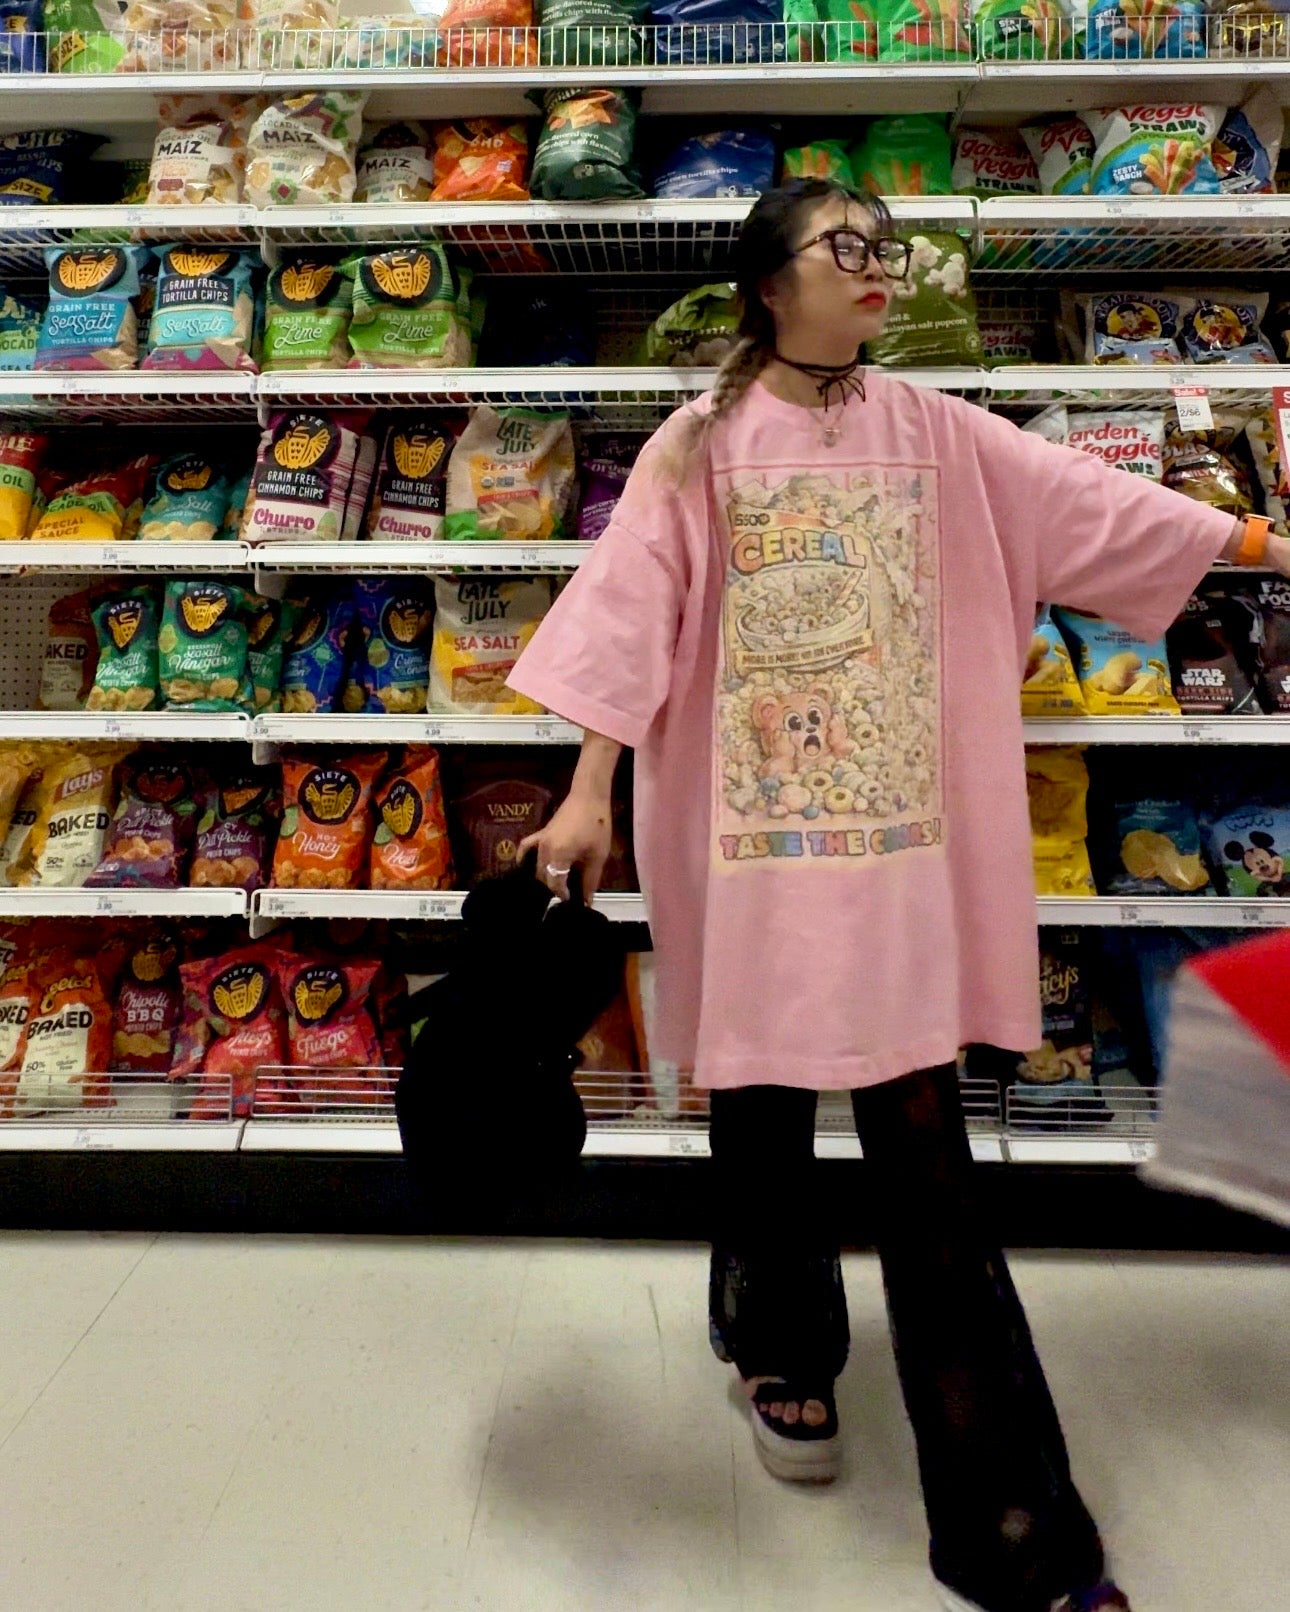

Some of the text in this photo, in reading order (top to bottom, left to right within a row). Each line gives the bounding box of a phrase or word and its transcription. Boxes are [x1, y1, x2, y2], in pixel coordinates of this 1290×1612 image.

[168, 277, 219, 291] GRAIN FREE
[162, 288, 229, 304] TORTILLA CHIPS
[85, 302, 116, 312] FREE
[384, 320, 434, 343] Lime
[918, 317, 968, 330] salt popcorn
[274, 324, 323, 349] Lime
[3, 473, 24, 488] OIL
[267, 470, 317, 486] GRAIN FREE
[257, 482, 325, 500] CINNAMON CHIPS
[391, 479, 433, 496] GRAIN FREE
[383, 490, 440, 509] CINNAMON CHIPS
[36, 516, 84, 531] SPECIAL
[253, 507, 316, 531] Churro
[379, 515, 432, 539] Churro
[40, 526, 80, 539] SAUCE
[732, 527, 867, 576] CEREAL
[461, 600, 511, 624] JULY
[454, 635, 520, 651] SEA SALT
[1181, 676, 1225, 687] WARS
[1183, 668, 1223, 679] STAR
[62, 768, 104, 799] Lay's
[315, 771, 348, 783] SIETE
[487, 802, 535, 817] VANDY
[48, 812, 110, 839] BAKED
[292, 831, 342, 861] Honey
[719, 832, 802, 860] TASTE
[806, 830, 866, 856] THE
[127, 1008, 165, 1022] BBQ
[27, 1010, 94, 1041] BAKED
[297, 1030, 350, 1060] Fuego
